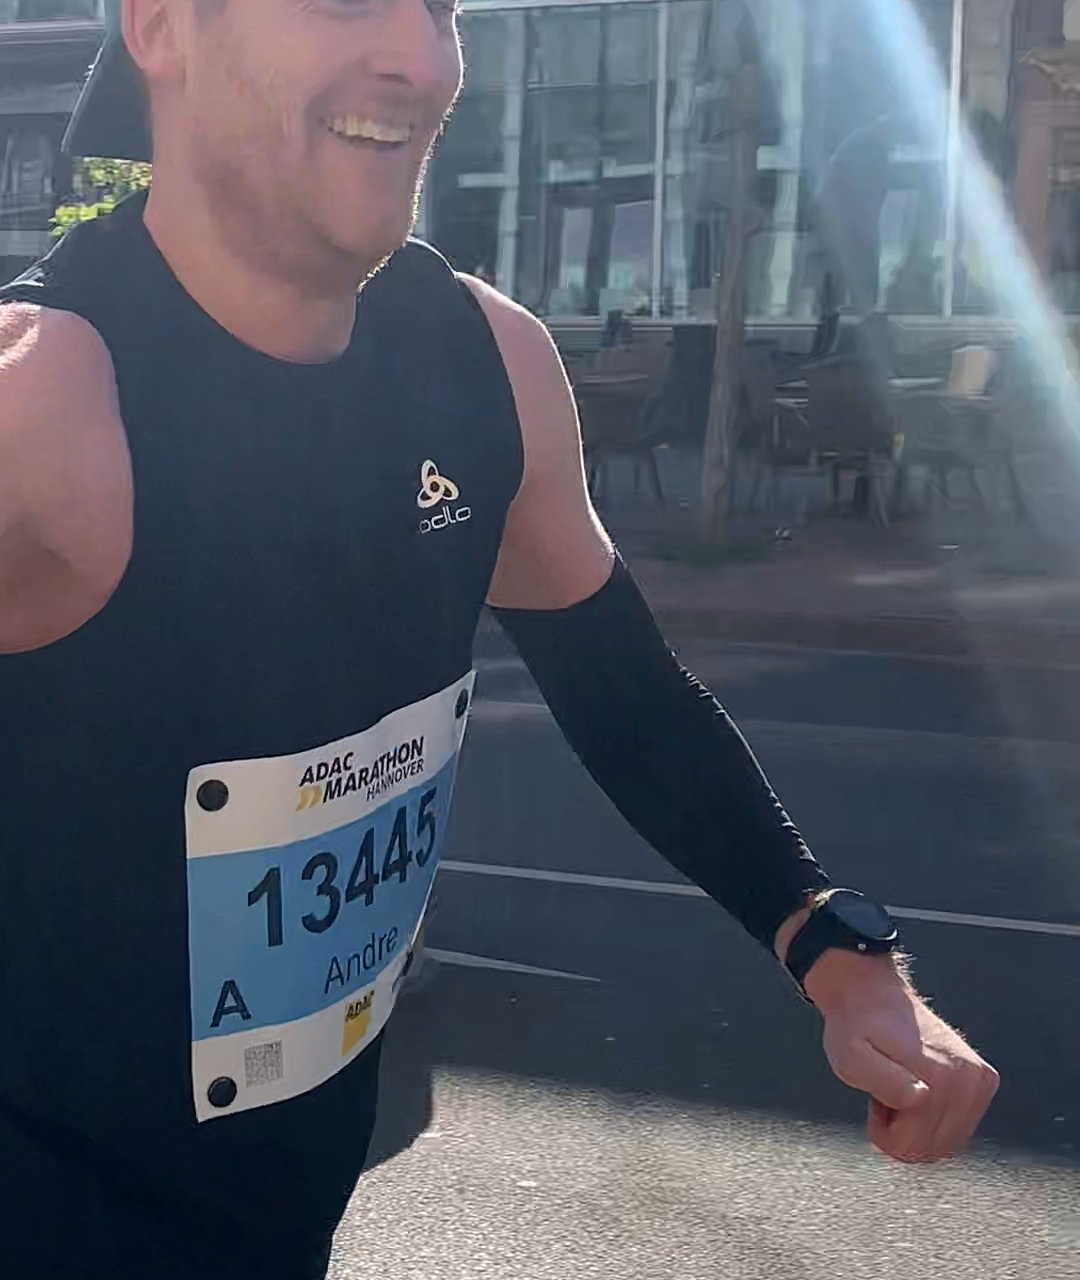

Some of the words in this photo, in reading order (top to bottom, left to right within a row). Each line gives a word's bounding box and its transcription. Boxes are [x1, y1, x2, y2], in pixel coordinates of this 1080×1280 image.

[420, 505, 471, 534] odlo
[299, 751, 354, 787] ADAC
[322, 736, 424, 804] MARATHON
[366, 758, 424, 801] HANNOVER
[247, 787, 437, 947] 13445
[324, 926, 398, 994] Andre
[210, 979, 252, 1027] A
